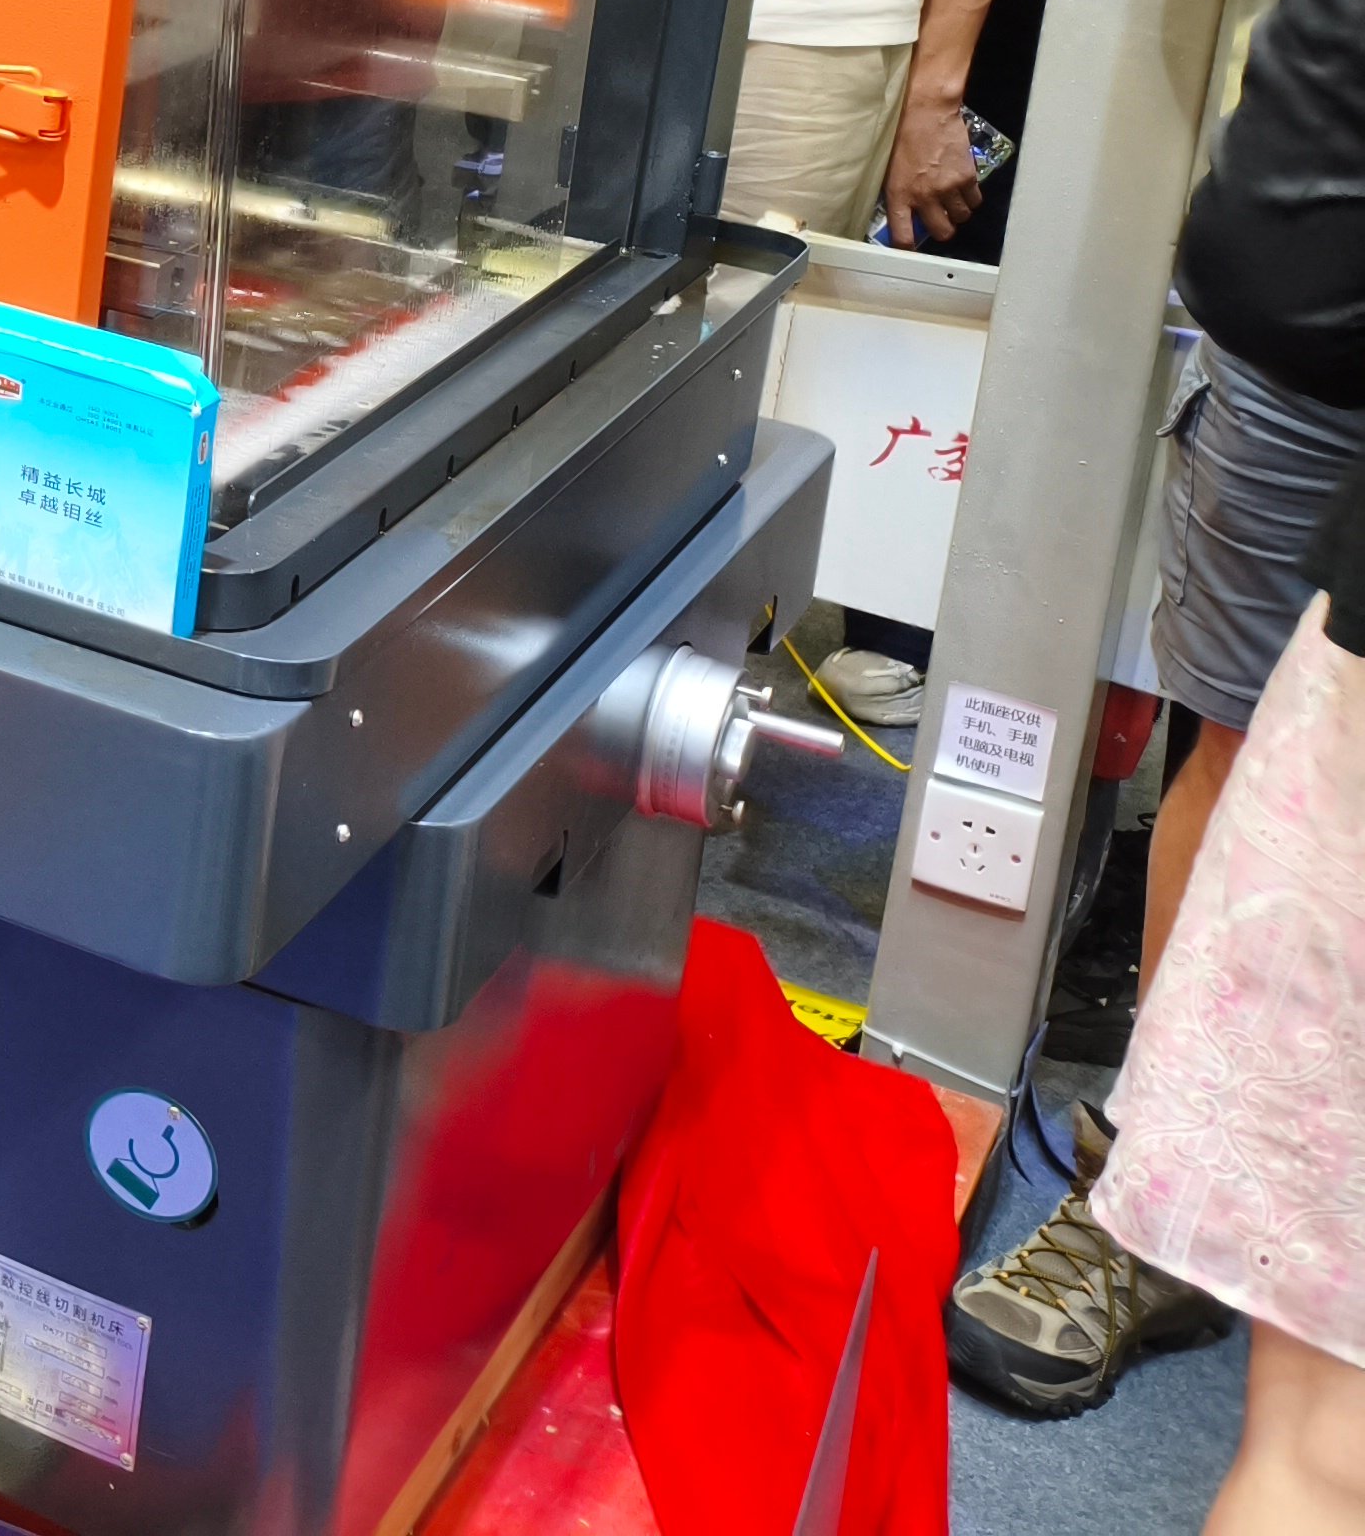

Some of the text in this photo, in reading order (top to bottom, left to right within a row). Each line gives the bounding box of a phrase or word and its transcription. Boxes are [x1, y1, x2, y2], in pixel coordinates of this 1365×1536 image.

[20, 464, 106, 506] 精益长城
[17, 488, 103, 529] 卓越钼丝
[964, 696, 1042, 729] 此插座仅供
[956, 752, 1001, 778] 机使用
[958, 735, 1035, 768] 电脑及电视
